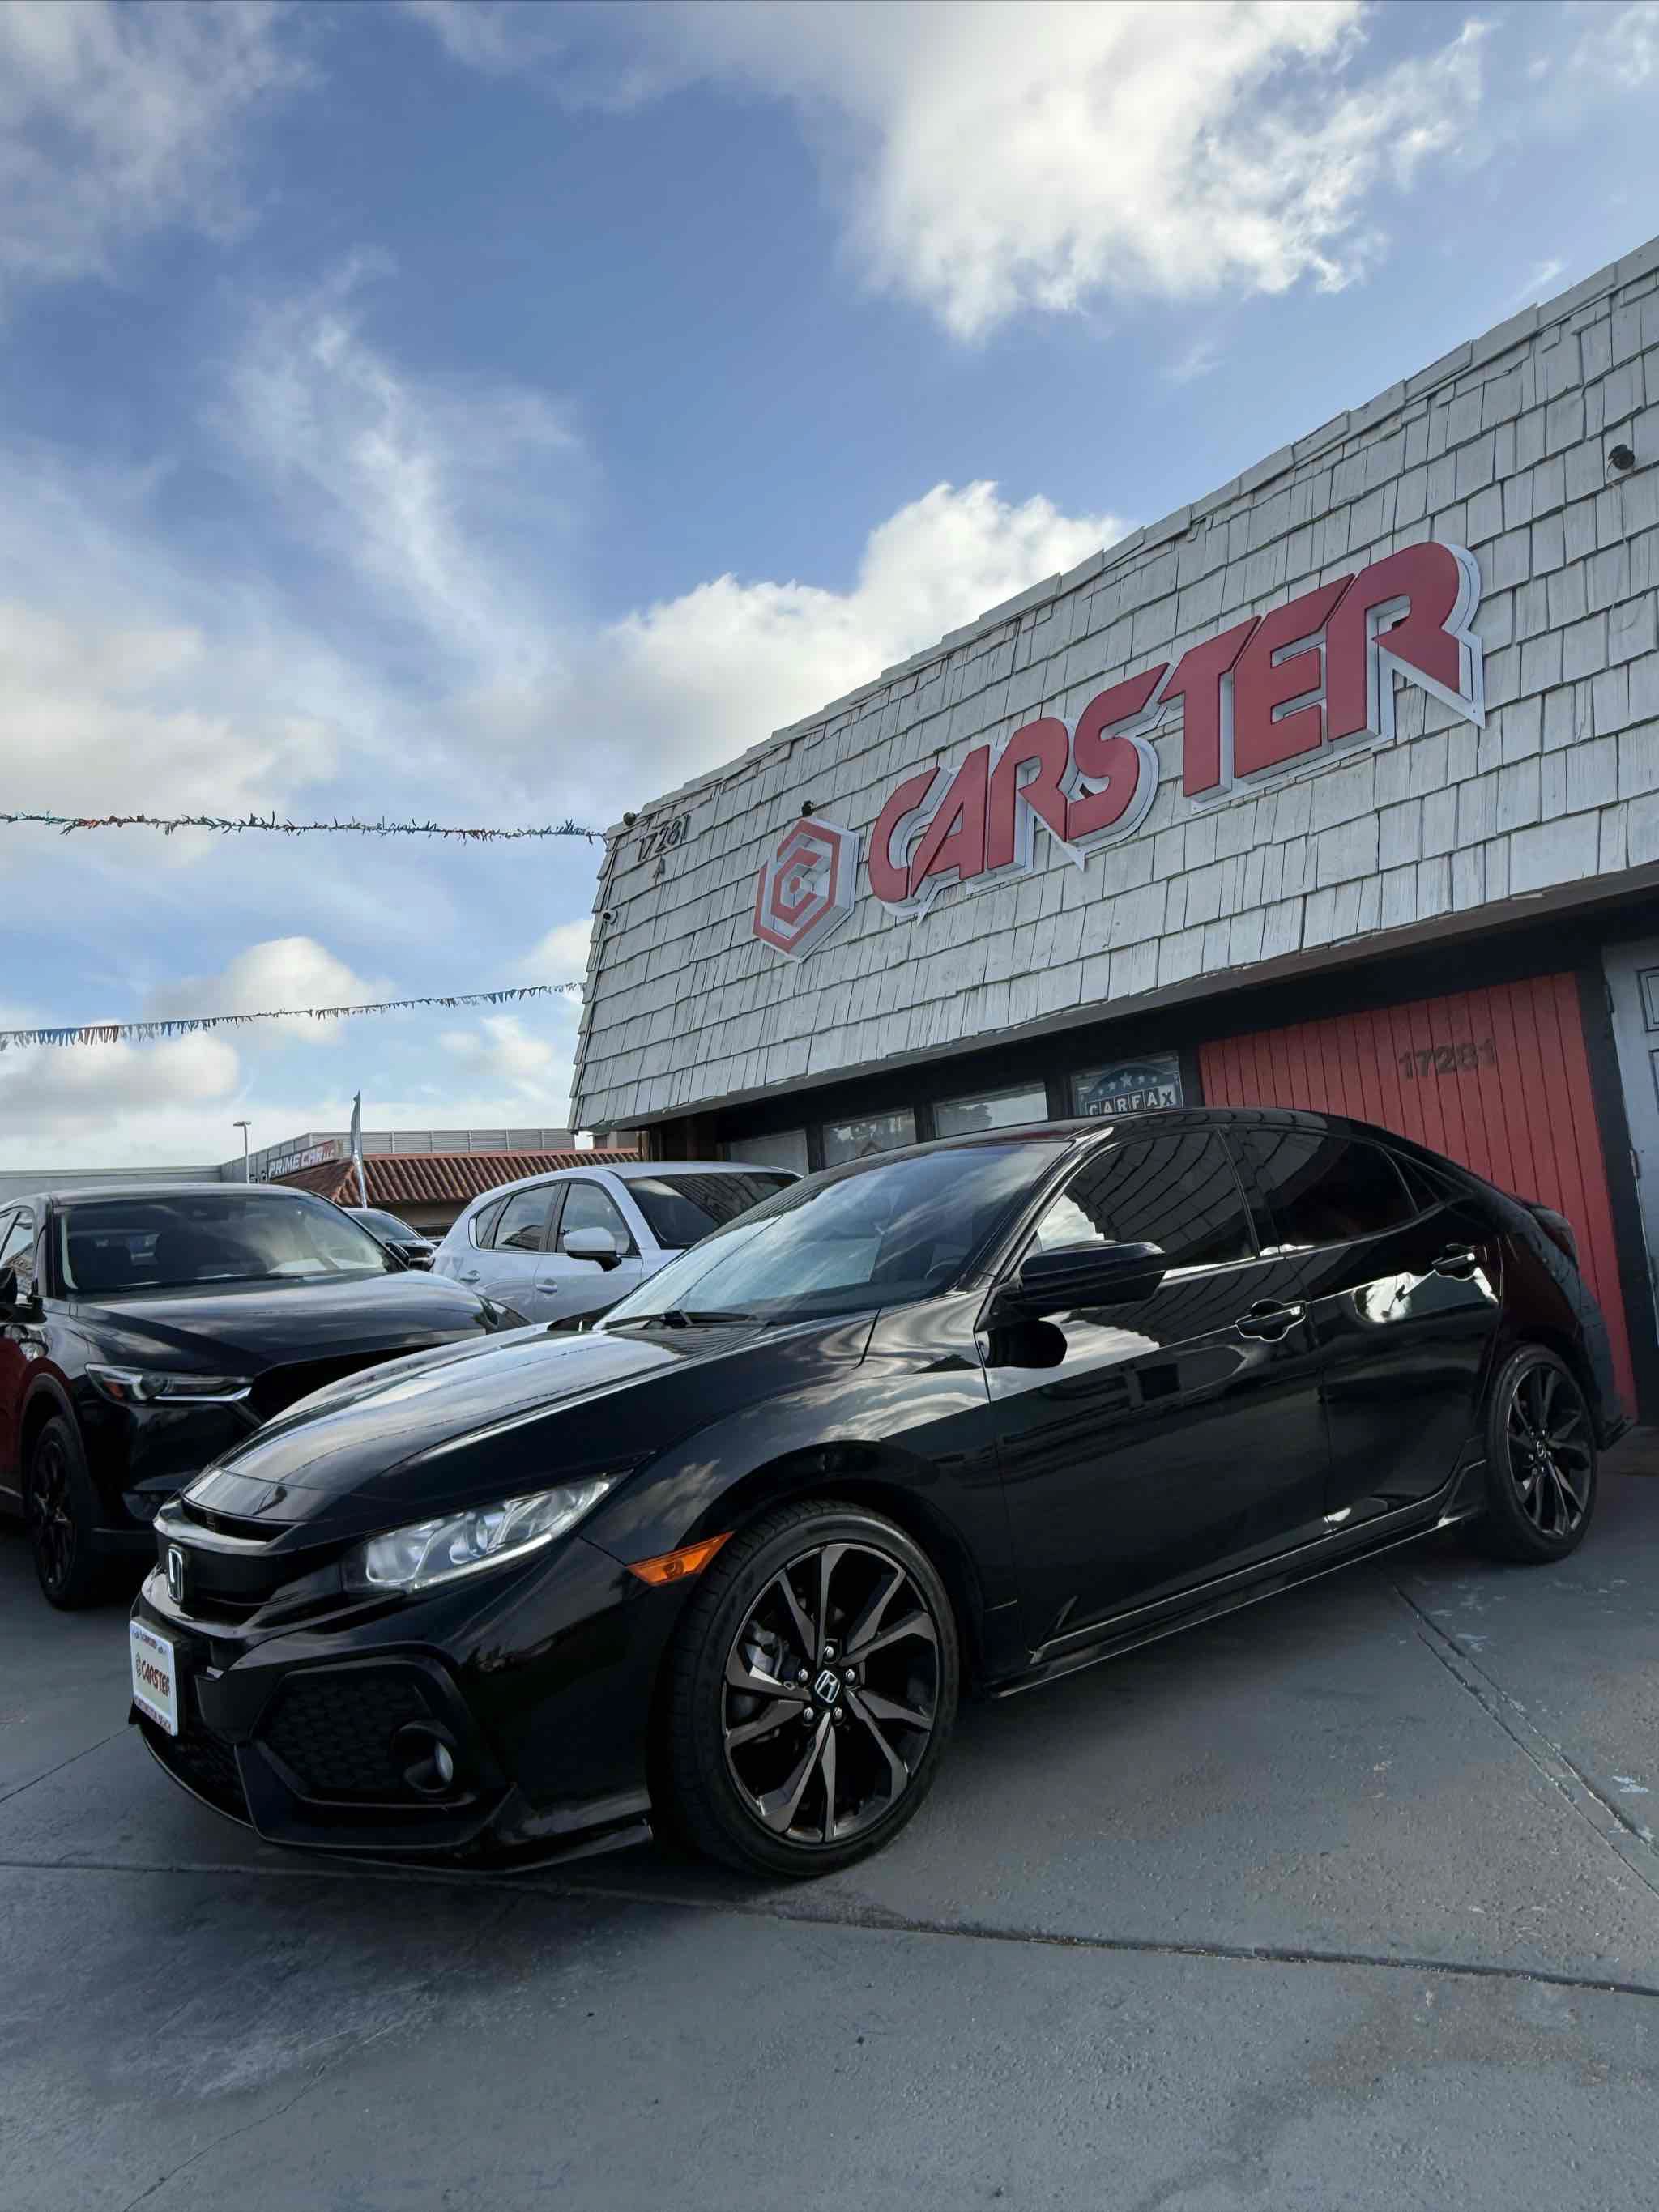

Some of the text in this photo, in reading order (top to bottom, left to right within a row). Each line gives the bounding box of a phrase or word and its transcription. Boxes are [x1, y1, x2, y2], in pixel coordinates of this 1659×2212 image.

[868, 541, 1476, 911] CARSTER
[637, 815, 692, 862] 17281
[1399, 1036, 1496, 1079] 17281
[1089, 1091, 1175, 1115] CARFAX
[269, 1153, 301, 1178] PRIME
